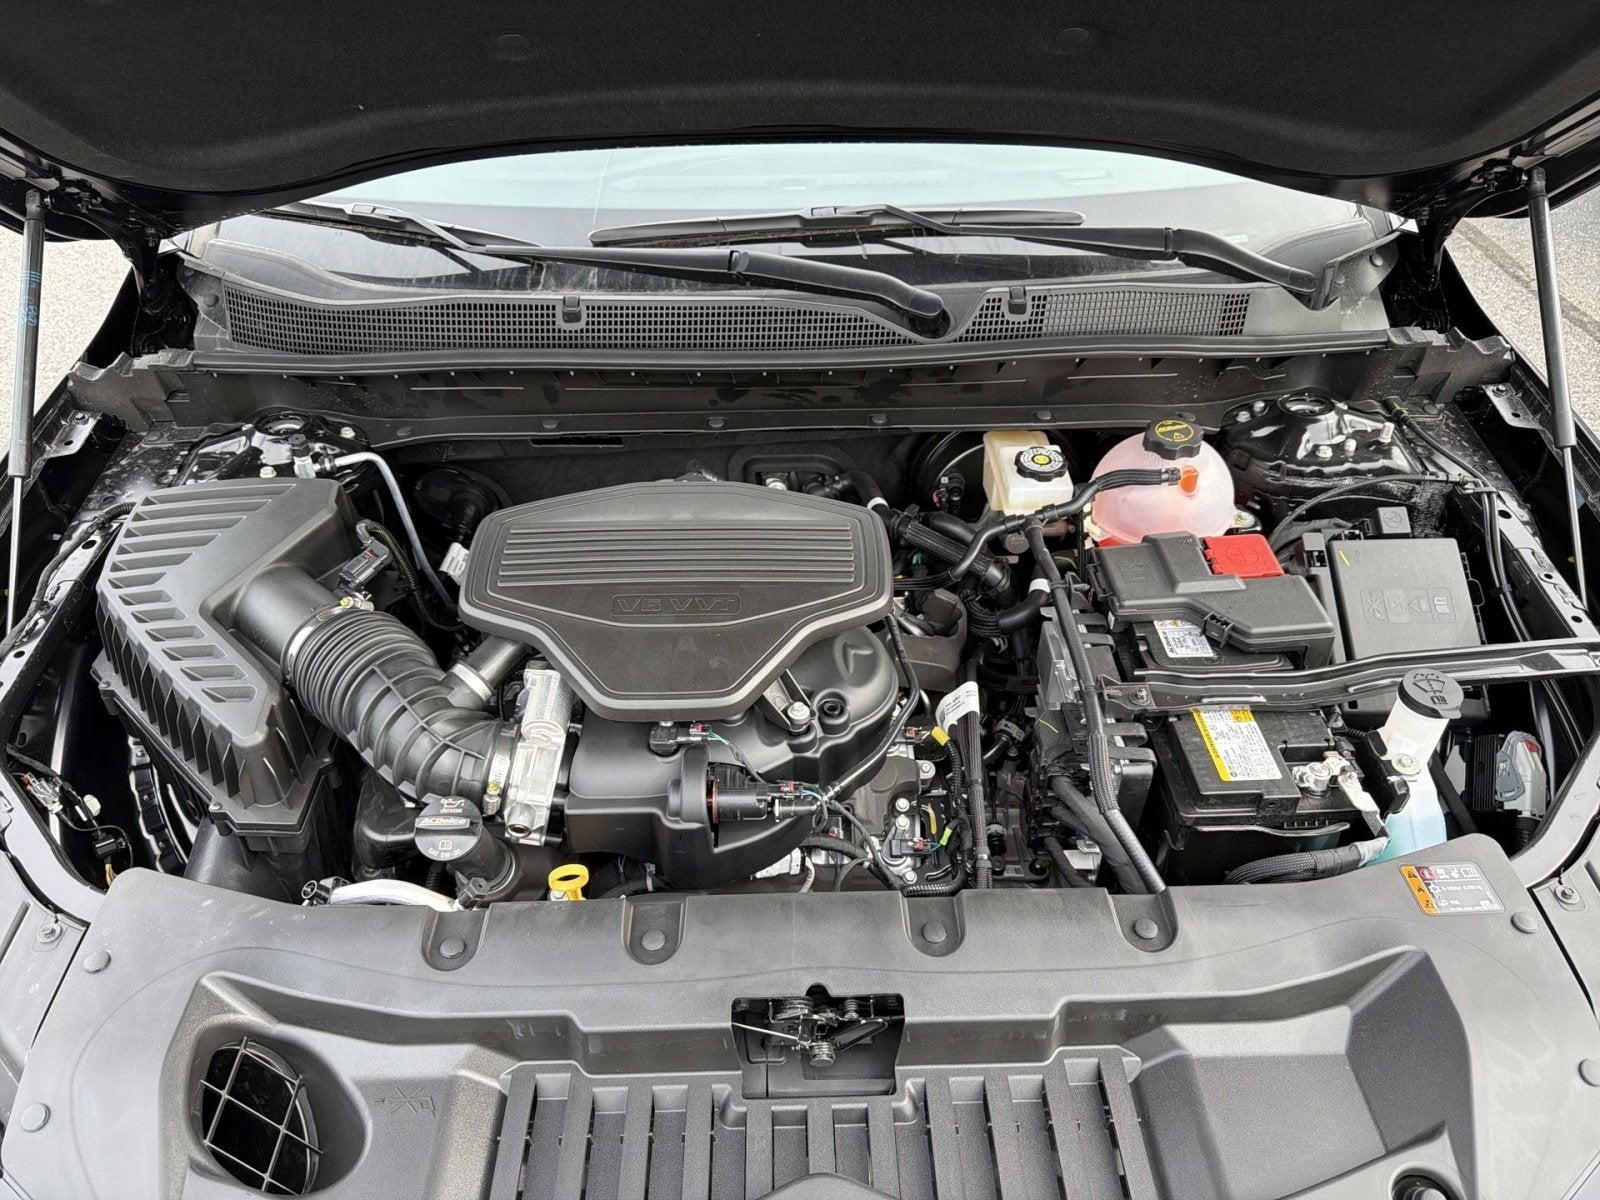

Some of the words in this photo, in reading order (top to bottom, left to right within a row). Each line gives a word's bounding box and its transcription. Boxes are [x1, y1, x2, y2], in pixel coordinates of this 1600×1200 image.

[616, 599, 662, 612] V6
[668, 597, 736, 611] VVT
[420, 817, 466, 825] ACDelco
